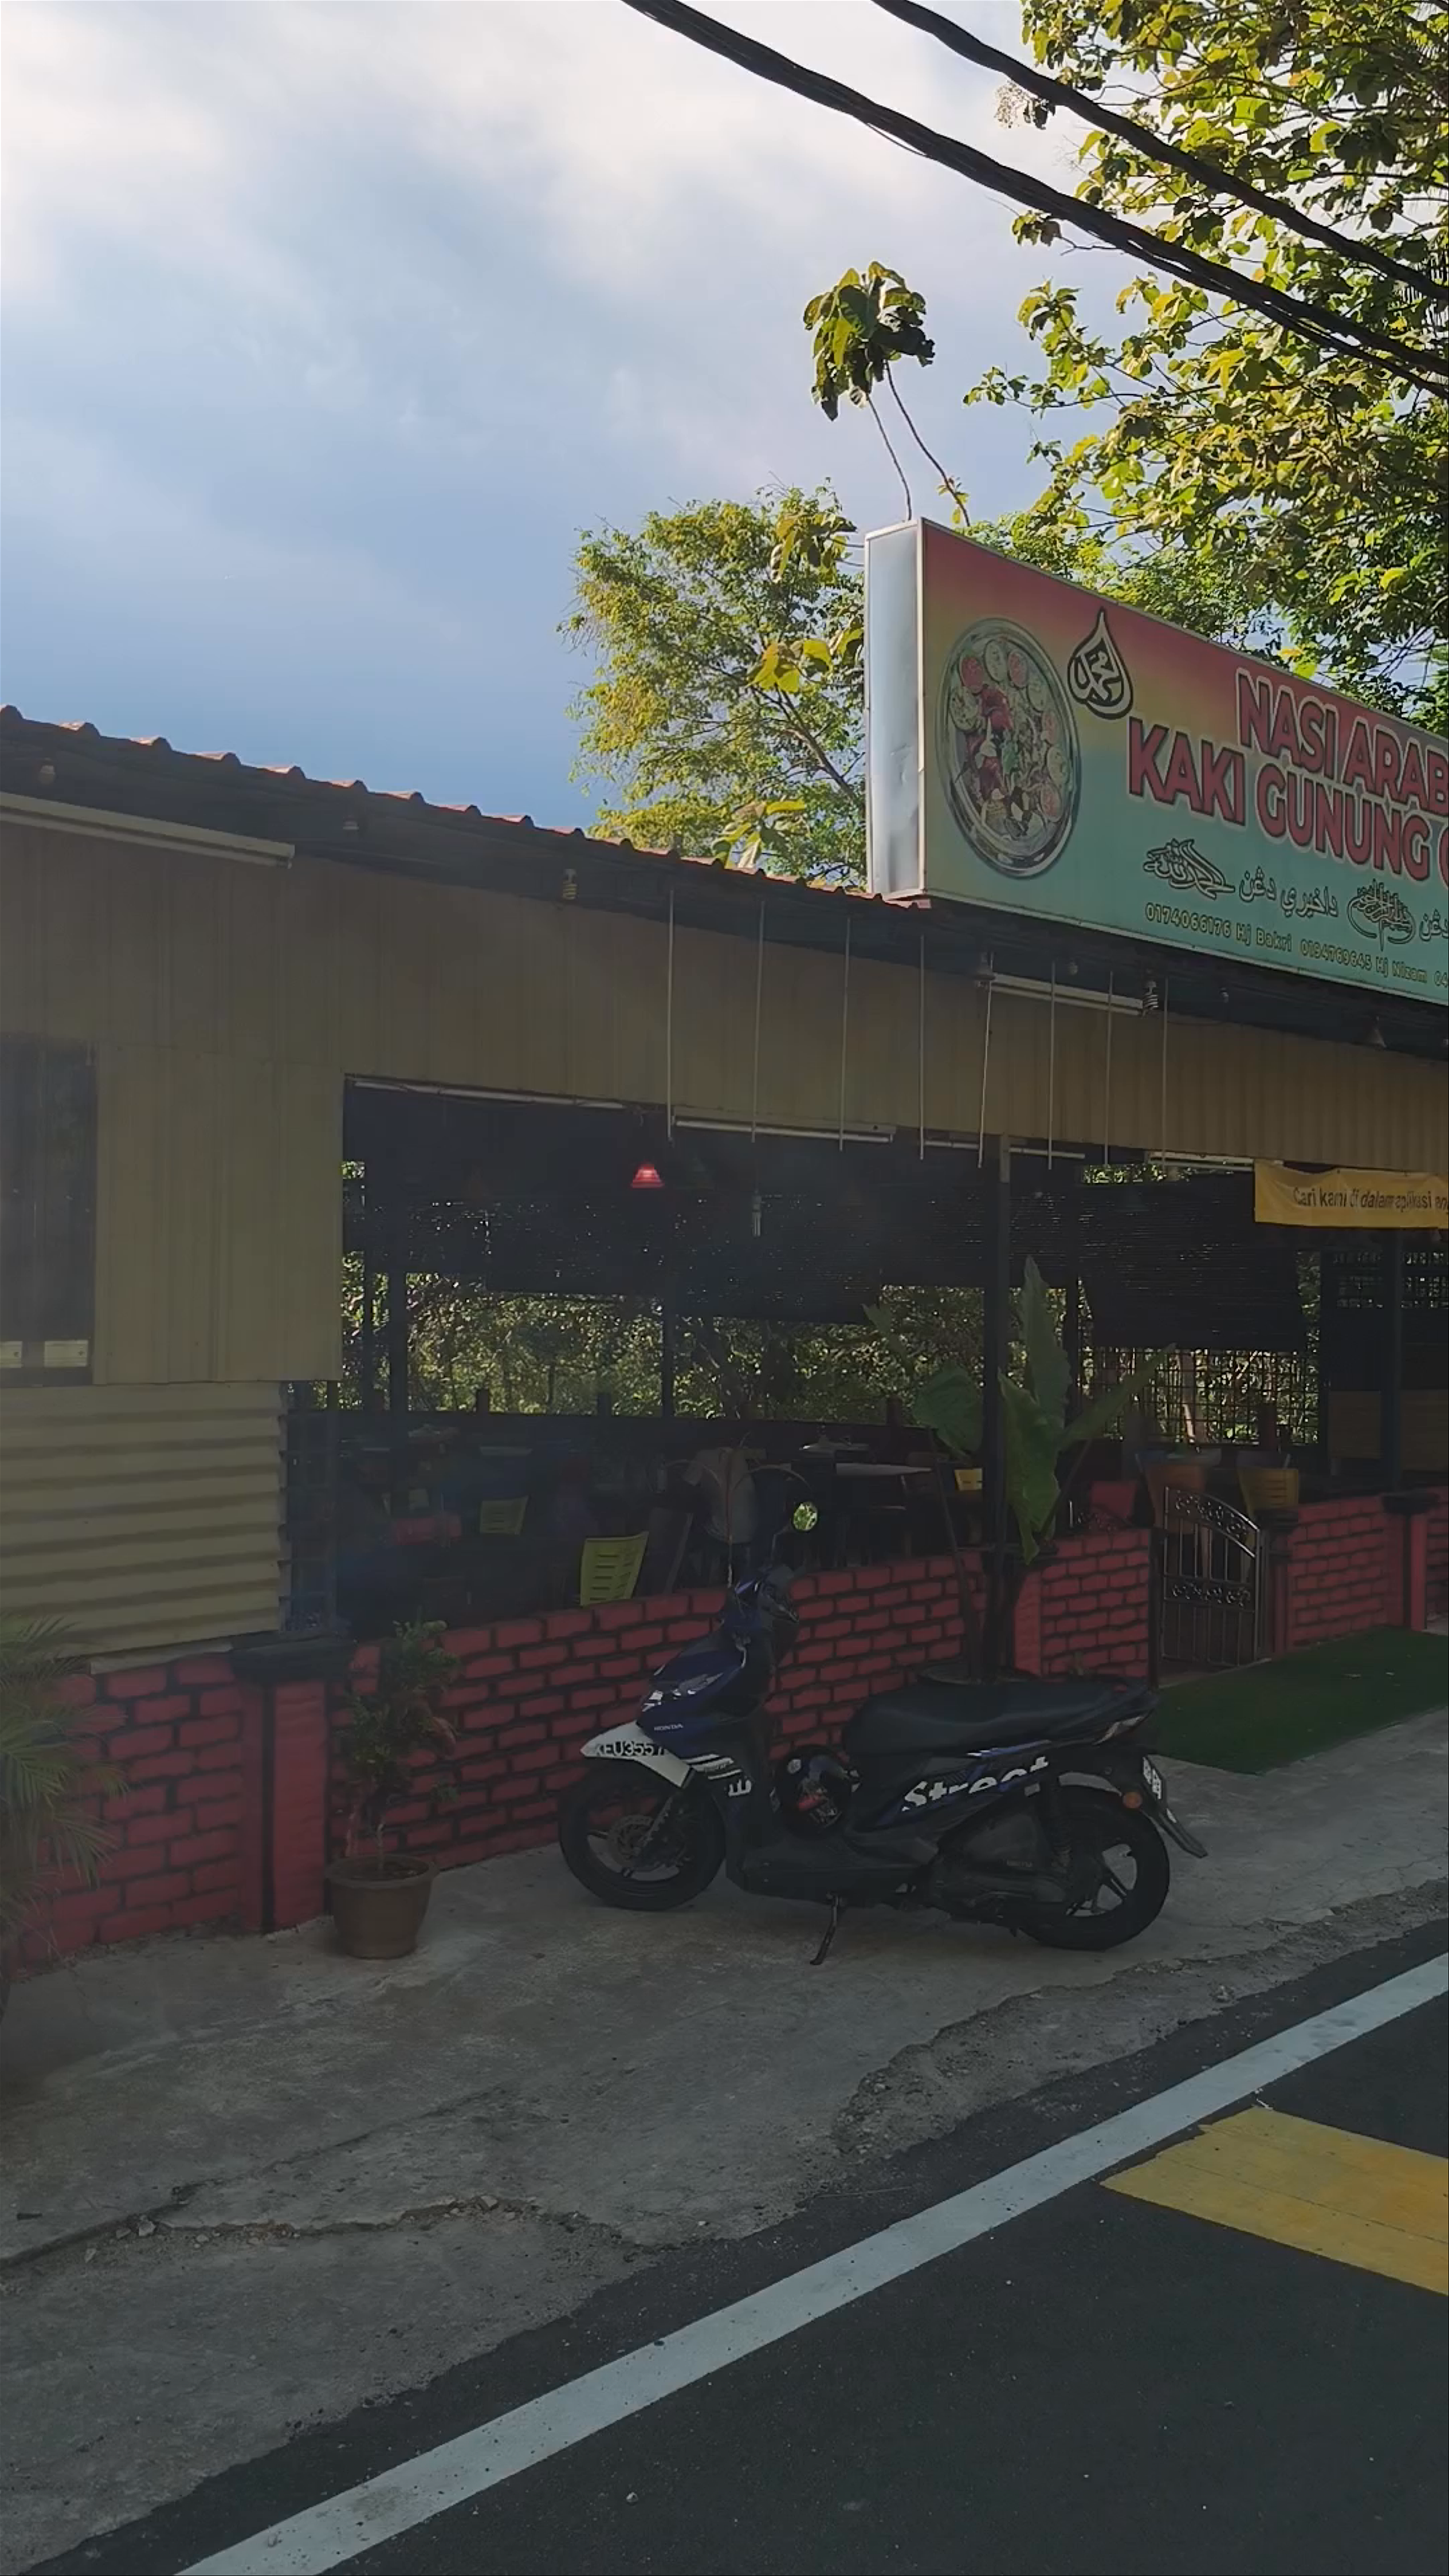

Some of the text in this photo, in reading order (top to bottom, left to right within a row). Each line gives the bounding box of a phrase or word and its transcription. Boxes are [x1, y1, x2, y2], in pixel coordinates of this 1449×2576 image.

[1238, 673, 1448, 817] NASI ARAB
[1128, 717, 1246, 826] KAKI
[1256, 763, 1430, 882] GUNUNG
[1146, 903, 1231, 938] 0174066176
[1237, 923, 1251, 946] Hj
[1257, 927, 1291, 952] Bakri
[1376, 957, 1388, 978] Hj
[1392, 960, 1427, 983] Nizam
[1293, 1187, 1316, 1207] Cari
[1319, 1187, 1347, 1207] kami
[1361, 1190, 1395, 1208] dalam
[654, 1722, 684, 1732] HONDA
